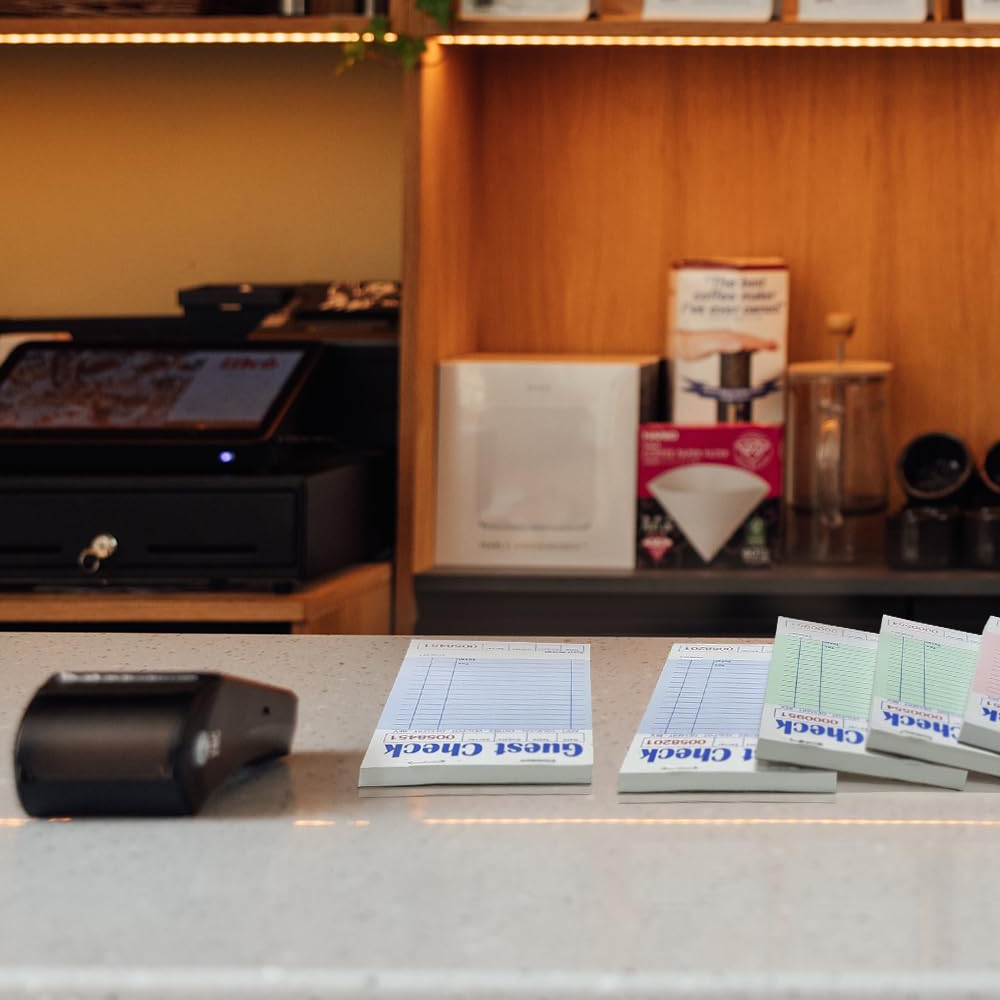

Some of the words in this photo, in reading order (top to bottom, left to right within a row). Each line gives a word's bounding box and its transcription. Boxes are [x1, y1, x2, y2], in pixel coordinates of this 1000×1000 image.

[780, 711, 839, 725] 0000951
[775, 718, 864, 745] Check
[384, 742, 483, 758] Check
[494, 742, 583, 758] Guest
[640, 747, 732, 763] Check
